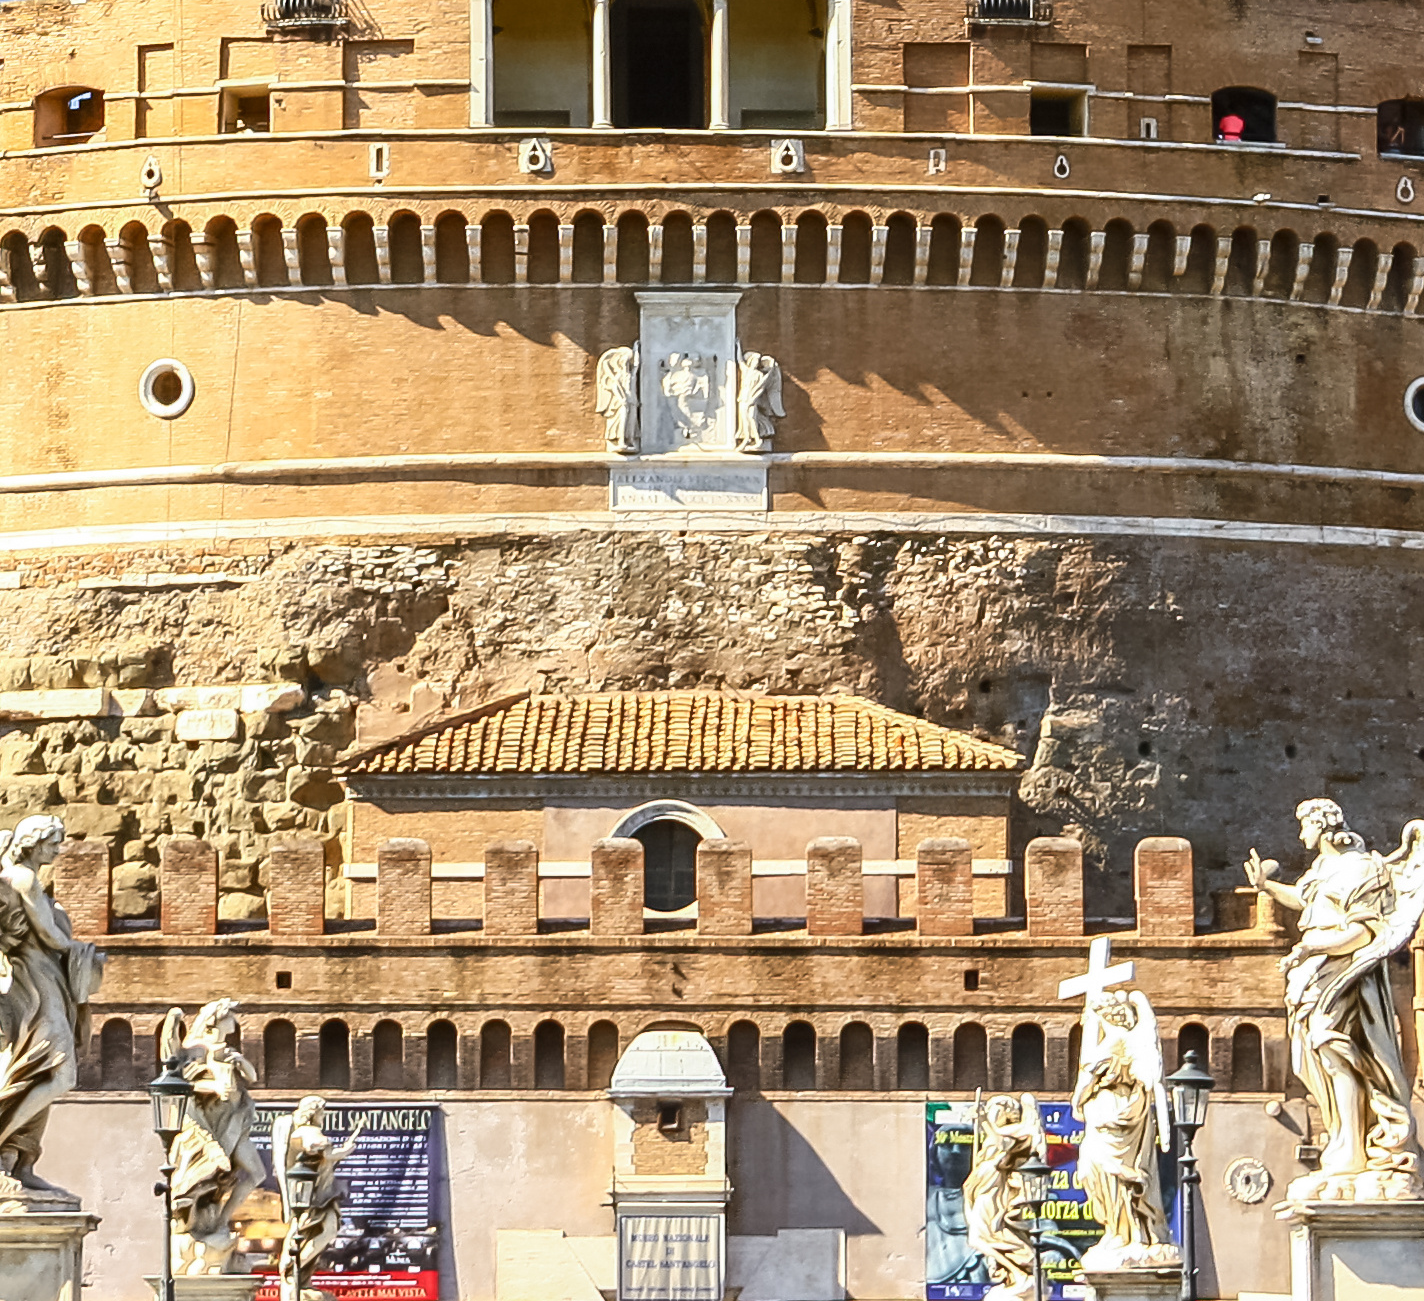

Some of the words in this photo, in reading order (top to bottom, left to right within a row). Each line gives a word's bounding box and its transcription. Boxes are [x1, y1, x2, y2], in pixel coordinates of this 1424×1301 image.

[631, 1233, 659, 1243] MUSEO
[664, 1233, 709, 1243] NAZIONALE
[626, 1259, 657, 1269] CASTEL
[400, 1288, 427, 1298] VISTA
